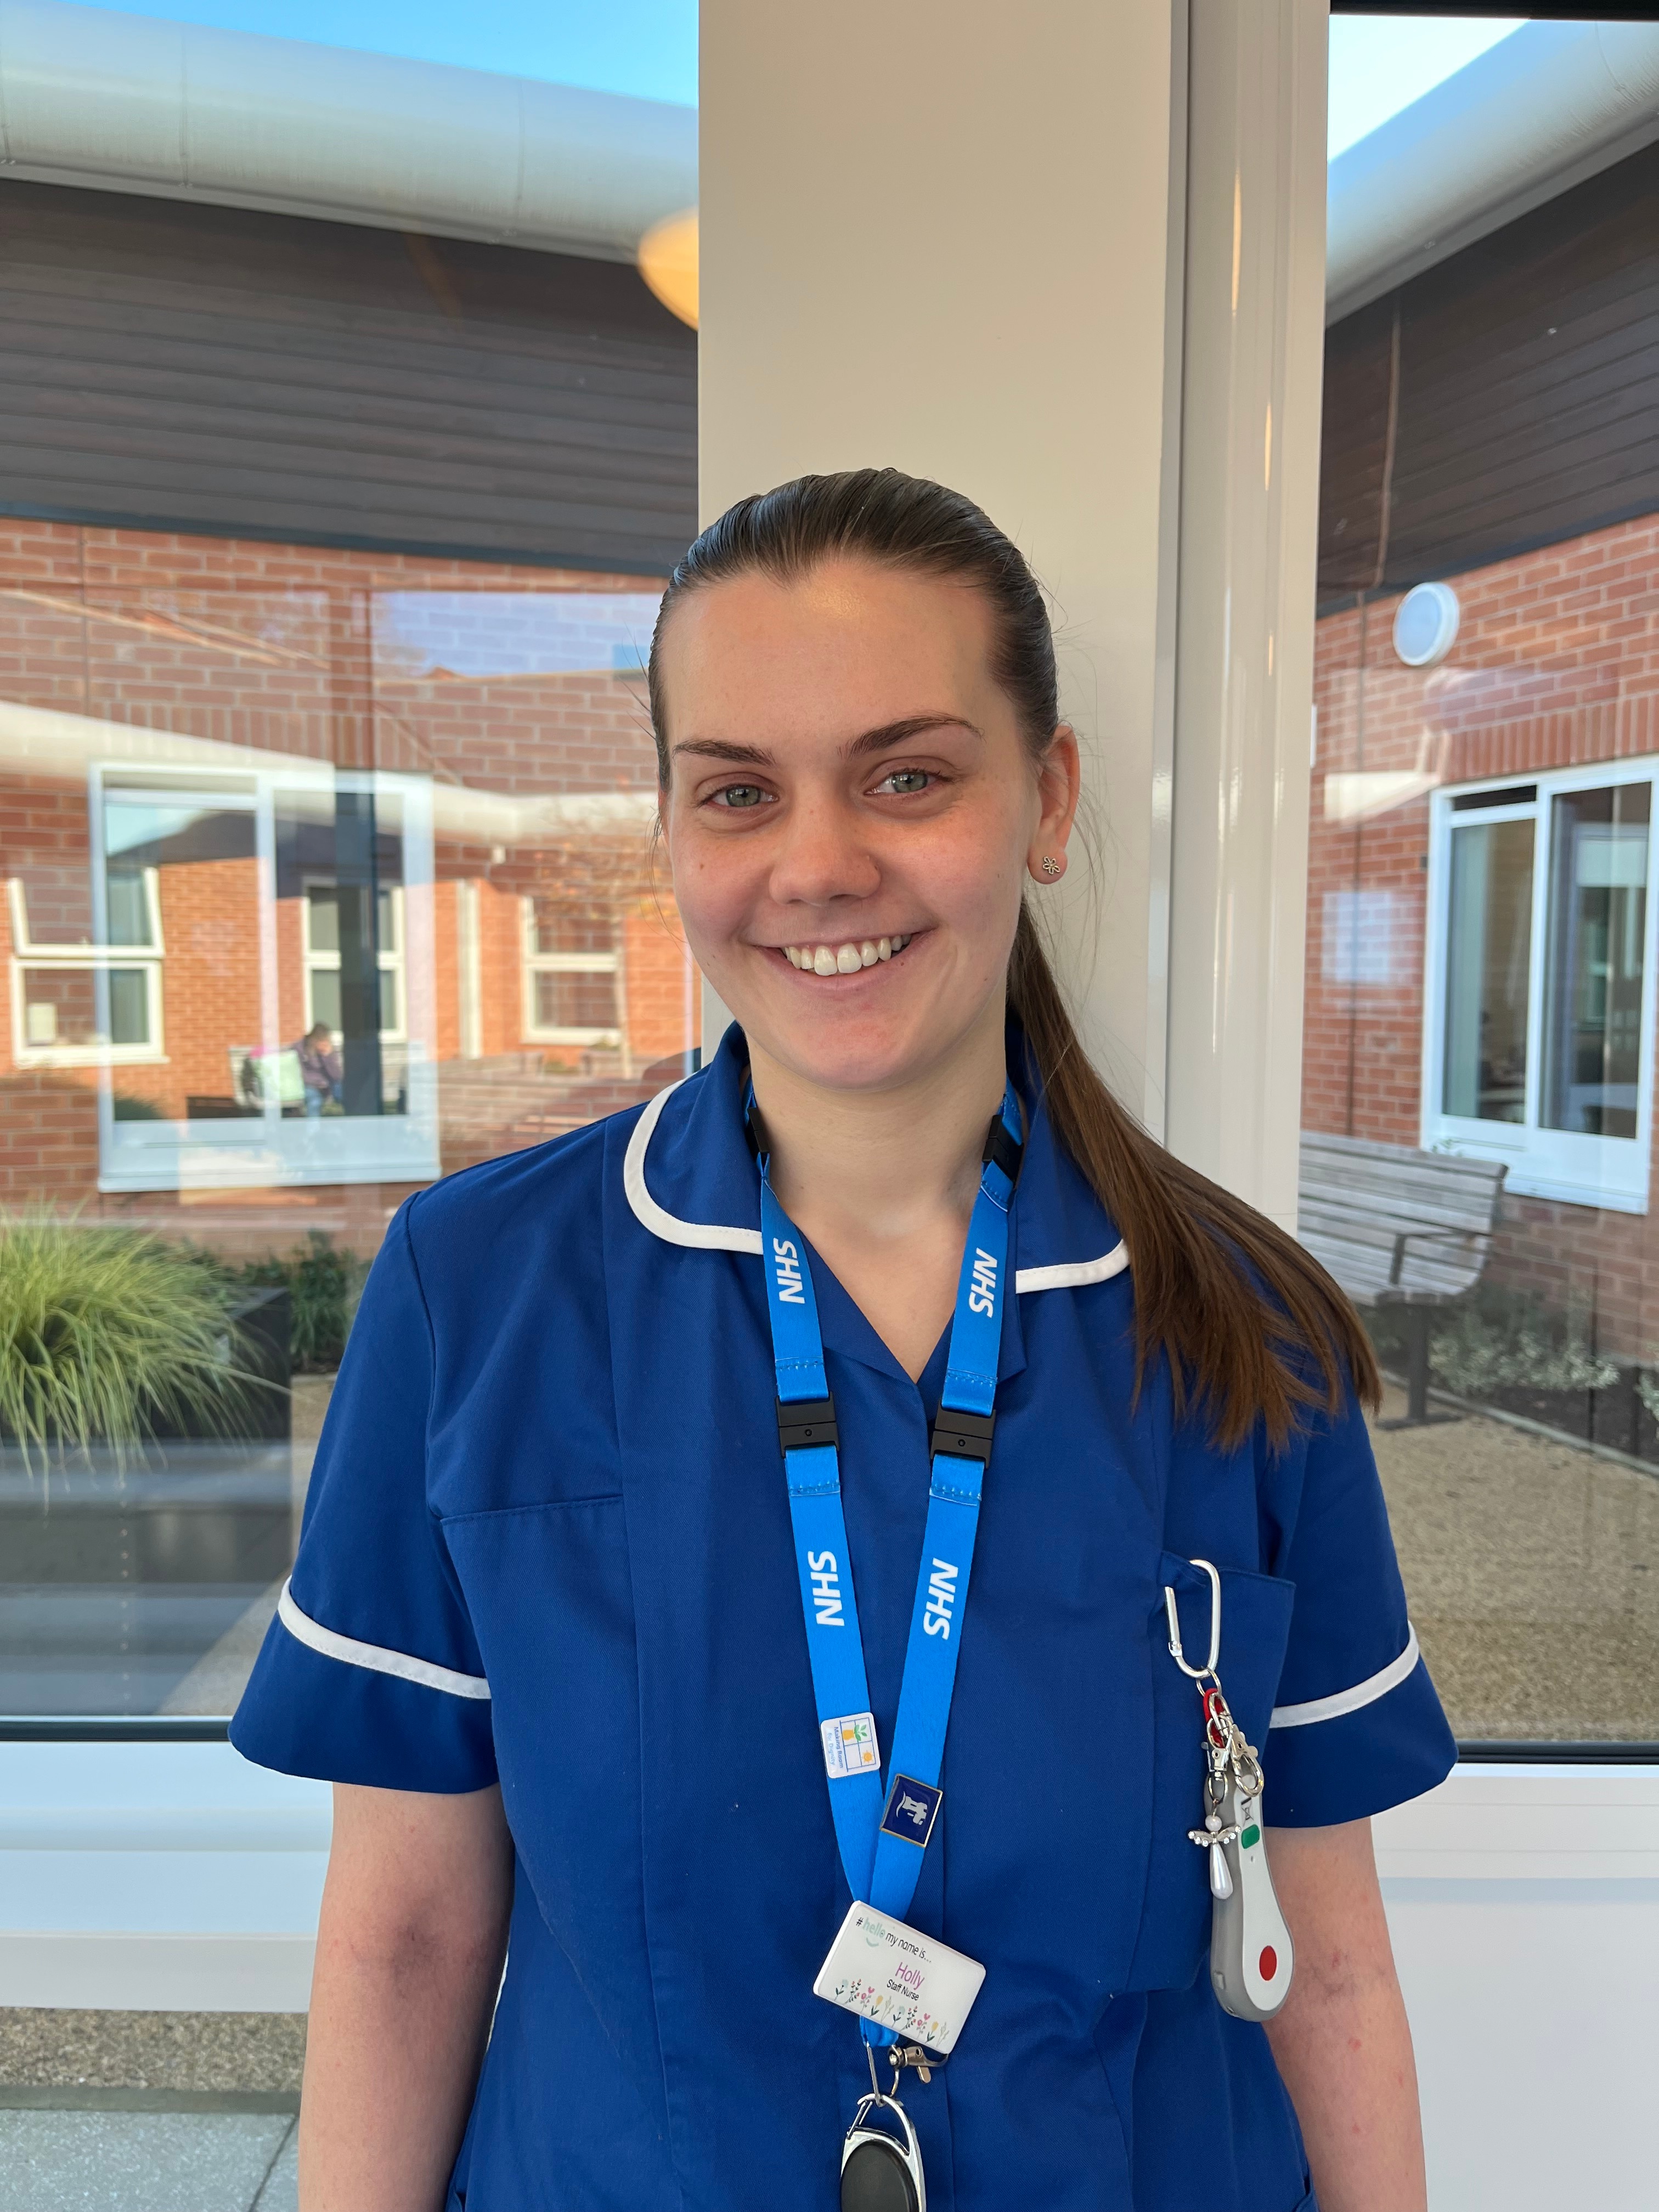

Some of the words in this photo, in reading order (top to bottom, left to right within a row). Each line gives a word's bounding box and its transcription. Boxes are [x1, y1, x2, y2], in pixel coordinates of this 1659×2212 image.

[774, 1238, 804, 1304] NHS
[969, 1248, 997, 1318] NHS
[808, 1551, 844, 1626] NHS
[924, 1559, 958, 1639] NHS
[885, 1933, 898, 1946] my
[898, 1939, 919, 1955] name
[895, 1962, 924, 1990] Holly
[887, 1979, 902, 1993] Staff
[901, 1985, 919, 2001] Nurse
